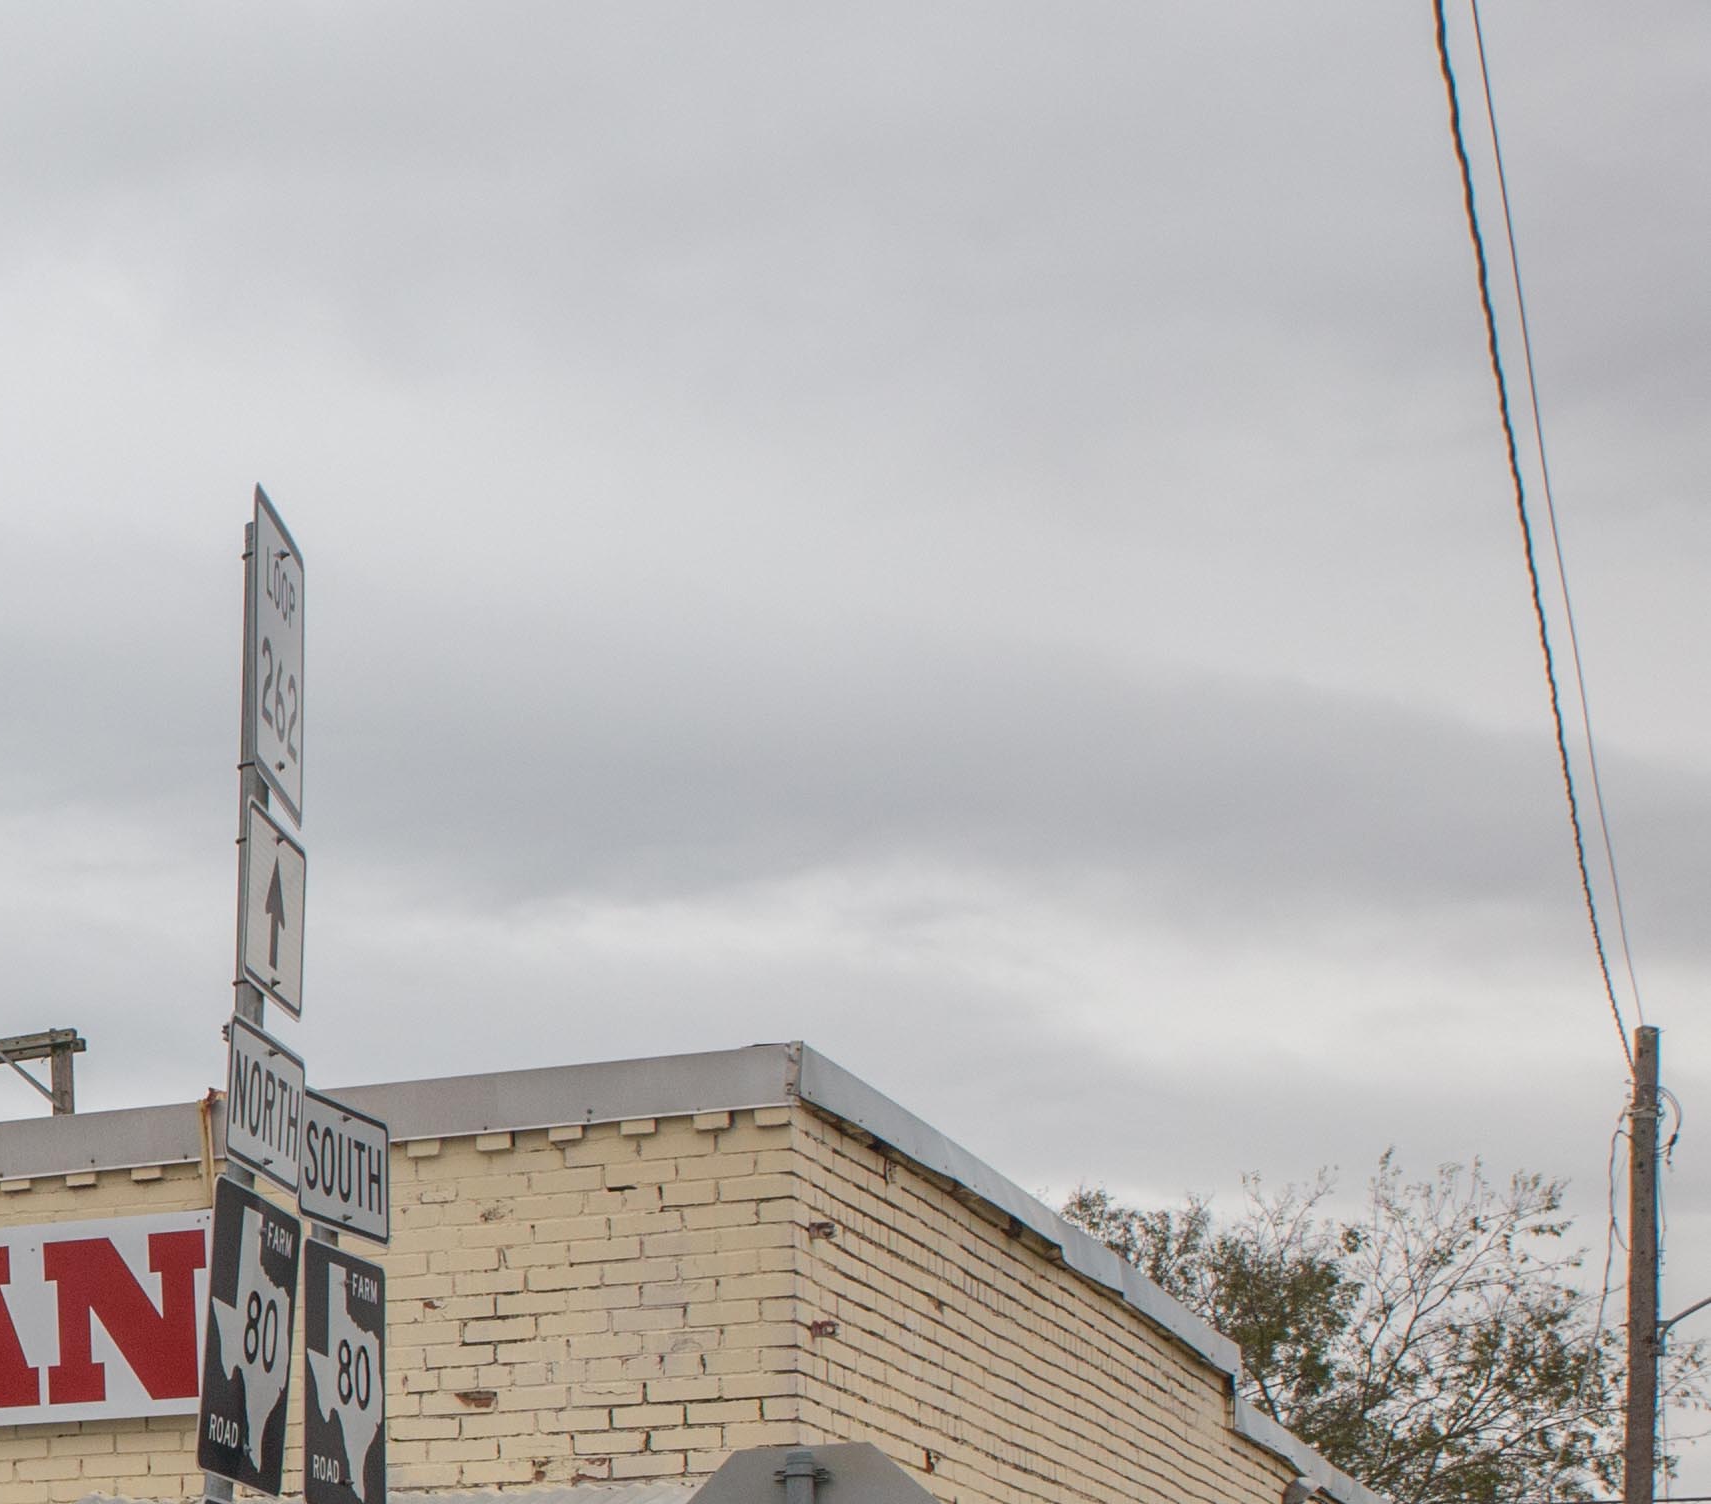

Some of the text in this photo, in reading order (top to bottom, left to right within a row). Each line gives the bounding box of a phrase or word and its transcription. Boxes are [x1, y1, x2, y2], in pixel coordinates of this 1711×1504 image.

[266, 546, 296, 629] LOOP
[261, 635, 298, 765] 262
[232, 1049, 300, 1163] NORTH
[304, 1119, 382, 1216] SOUTH
[266, 1221, 293, 1260] FARM
[351, 1272, 378, 1305] FARM
[243, 1290, 278, 1374] 80
[337, 1338, 371, 1411] 80
[209, 1412, 239, 1449] ROAD
[312, 1453, 340, 1484] ROAD
